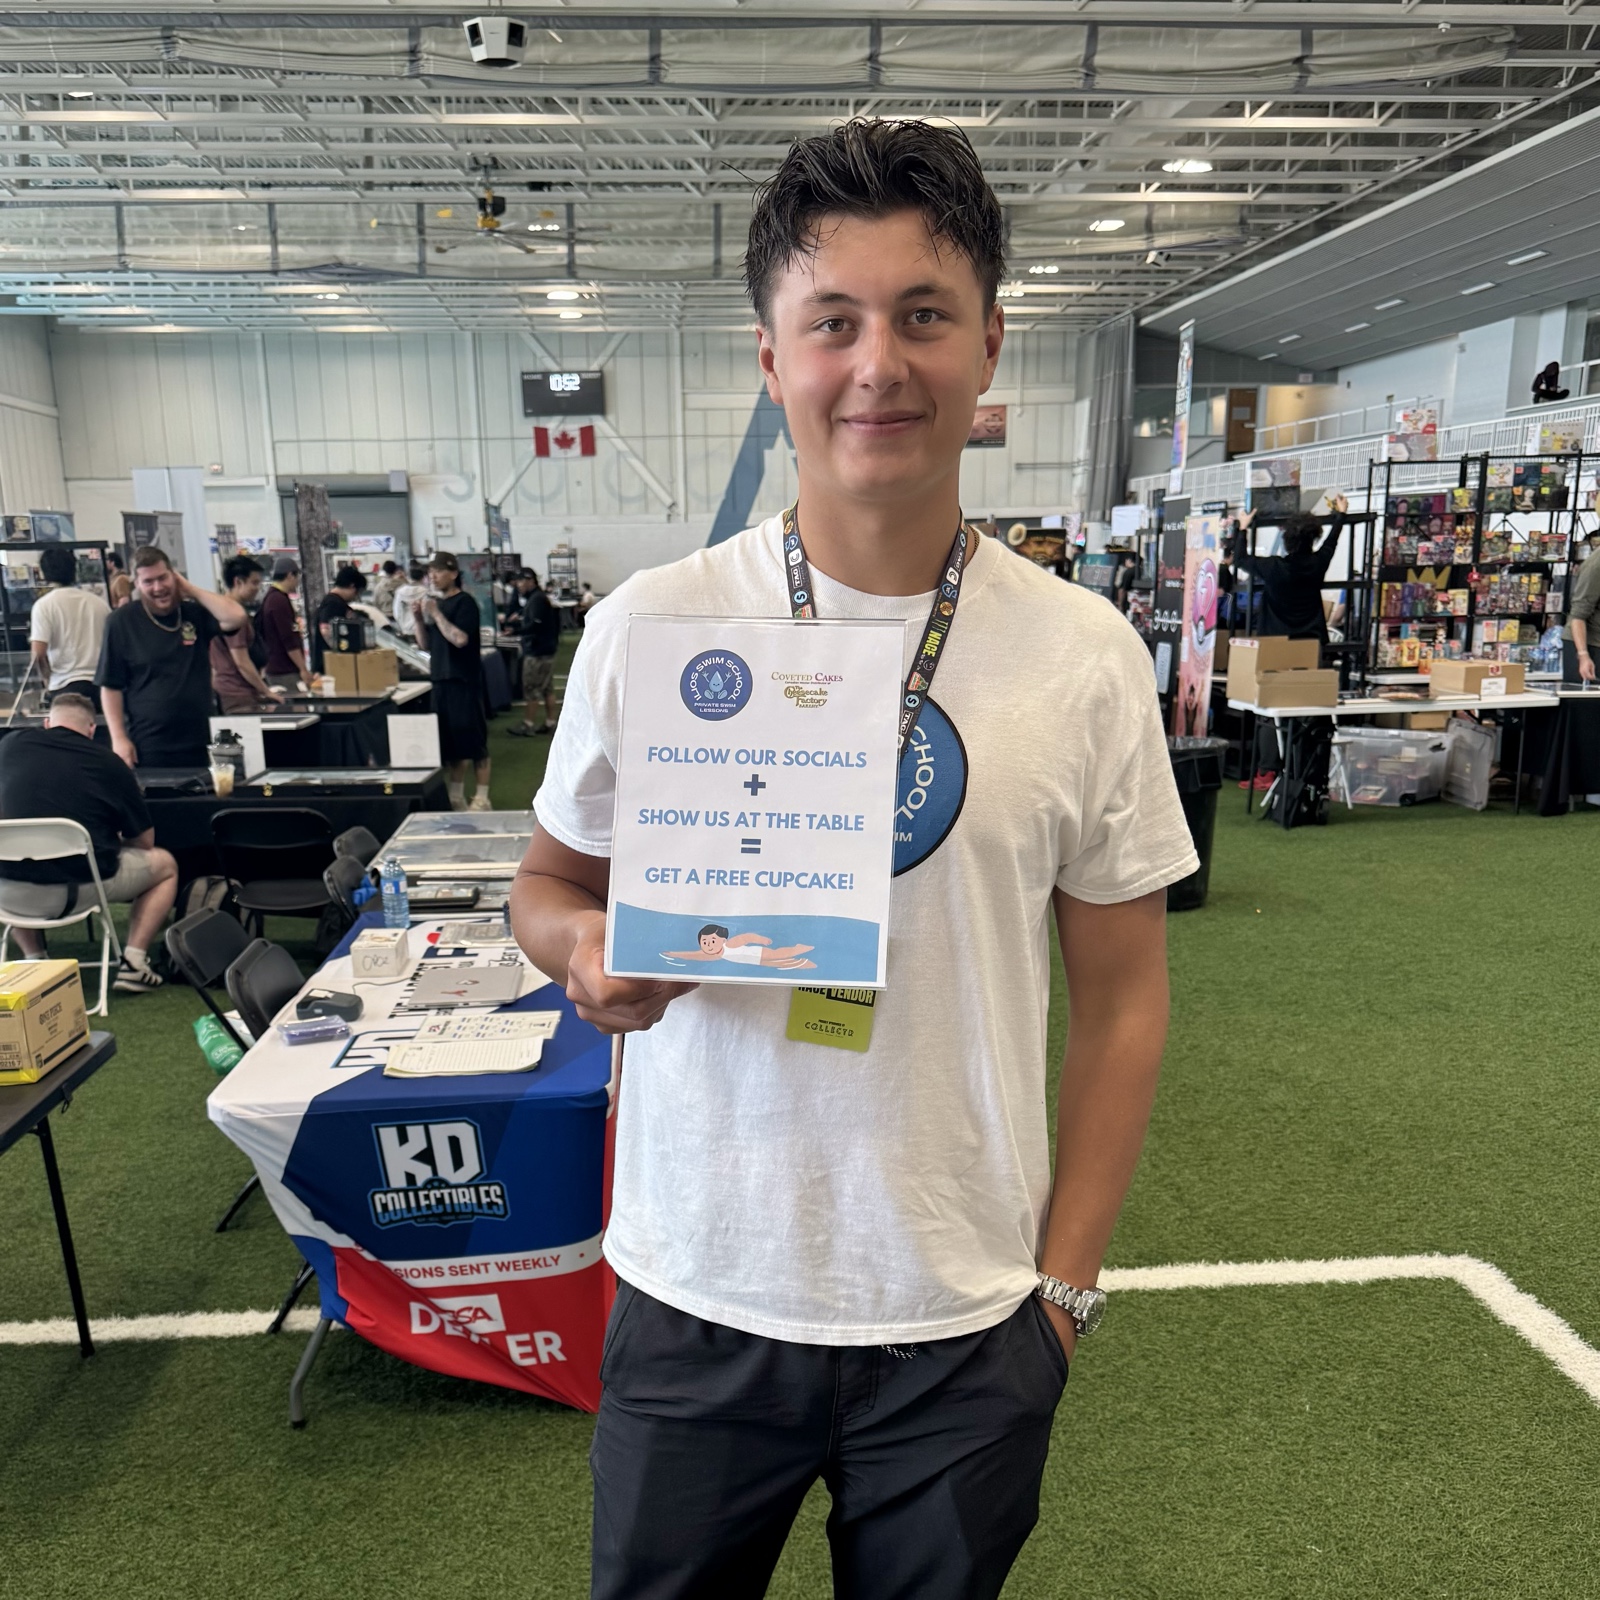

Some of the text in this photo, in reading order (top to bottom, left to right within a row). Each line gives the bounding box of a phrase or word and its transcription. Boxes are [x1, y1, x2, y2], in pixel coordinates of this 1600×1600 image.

[696, 656, 725, 672] SWIM
[725, 659, 743, 701] SCHOOL
[795, 696, 828, 706] Factory
[647, 746, 867, 768] FOLLOW OUR SOCIALS
[894, 725, 935, 820] CHOOL
[638, 808, 865, 831] SHOW US AT THE TABLE
[644, 867, 854, 890] GET A FREE CUPCAKE!
[830, 987, 875, 1004] VENDOR
[378, 1121, 481, 1188] KD
[373, 1185, 505, 1222] COLLECTIBLES
[394, 1254, 561, 1279] SIONS SENT WEEKLY
